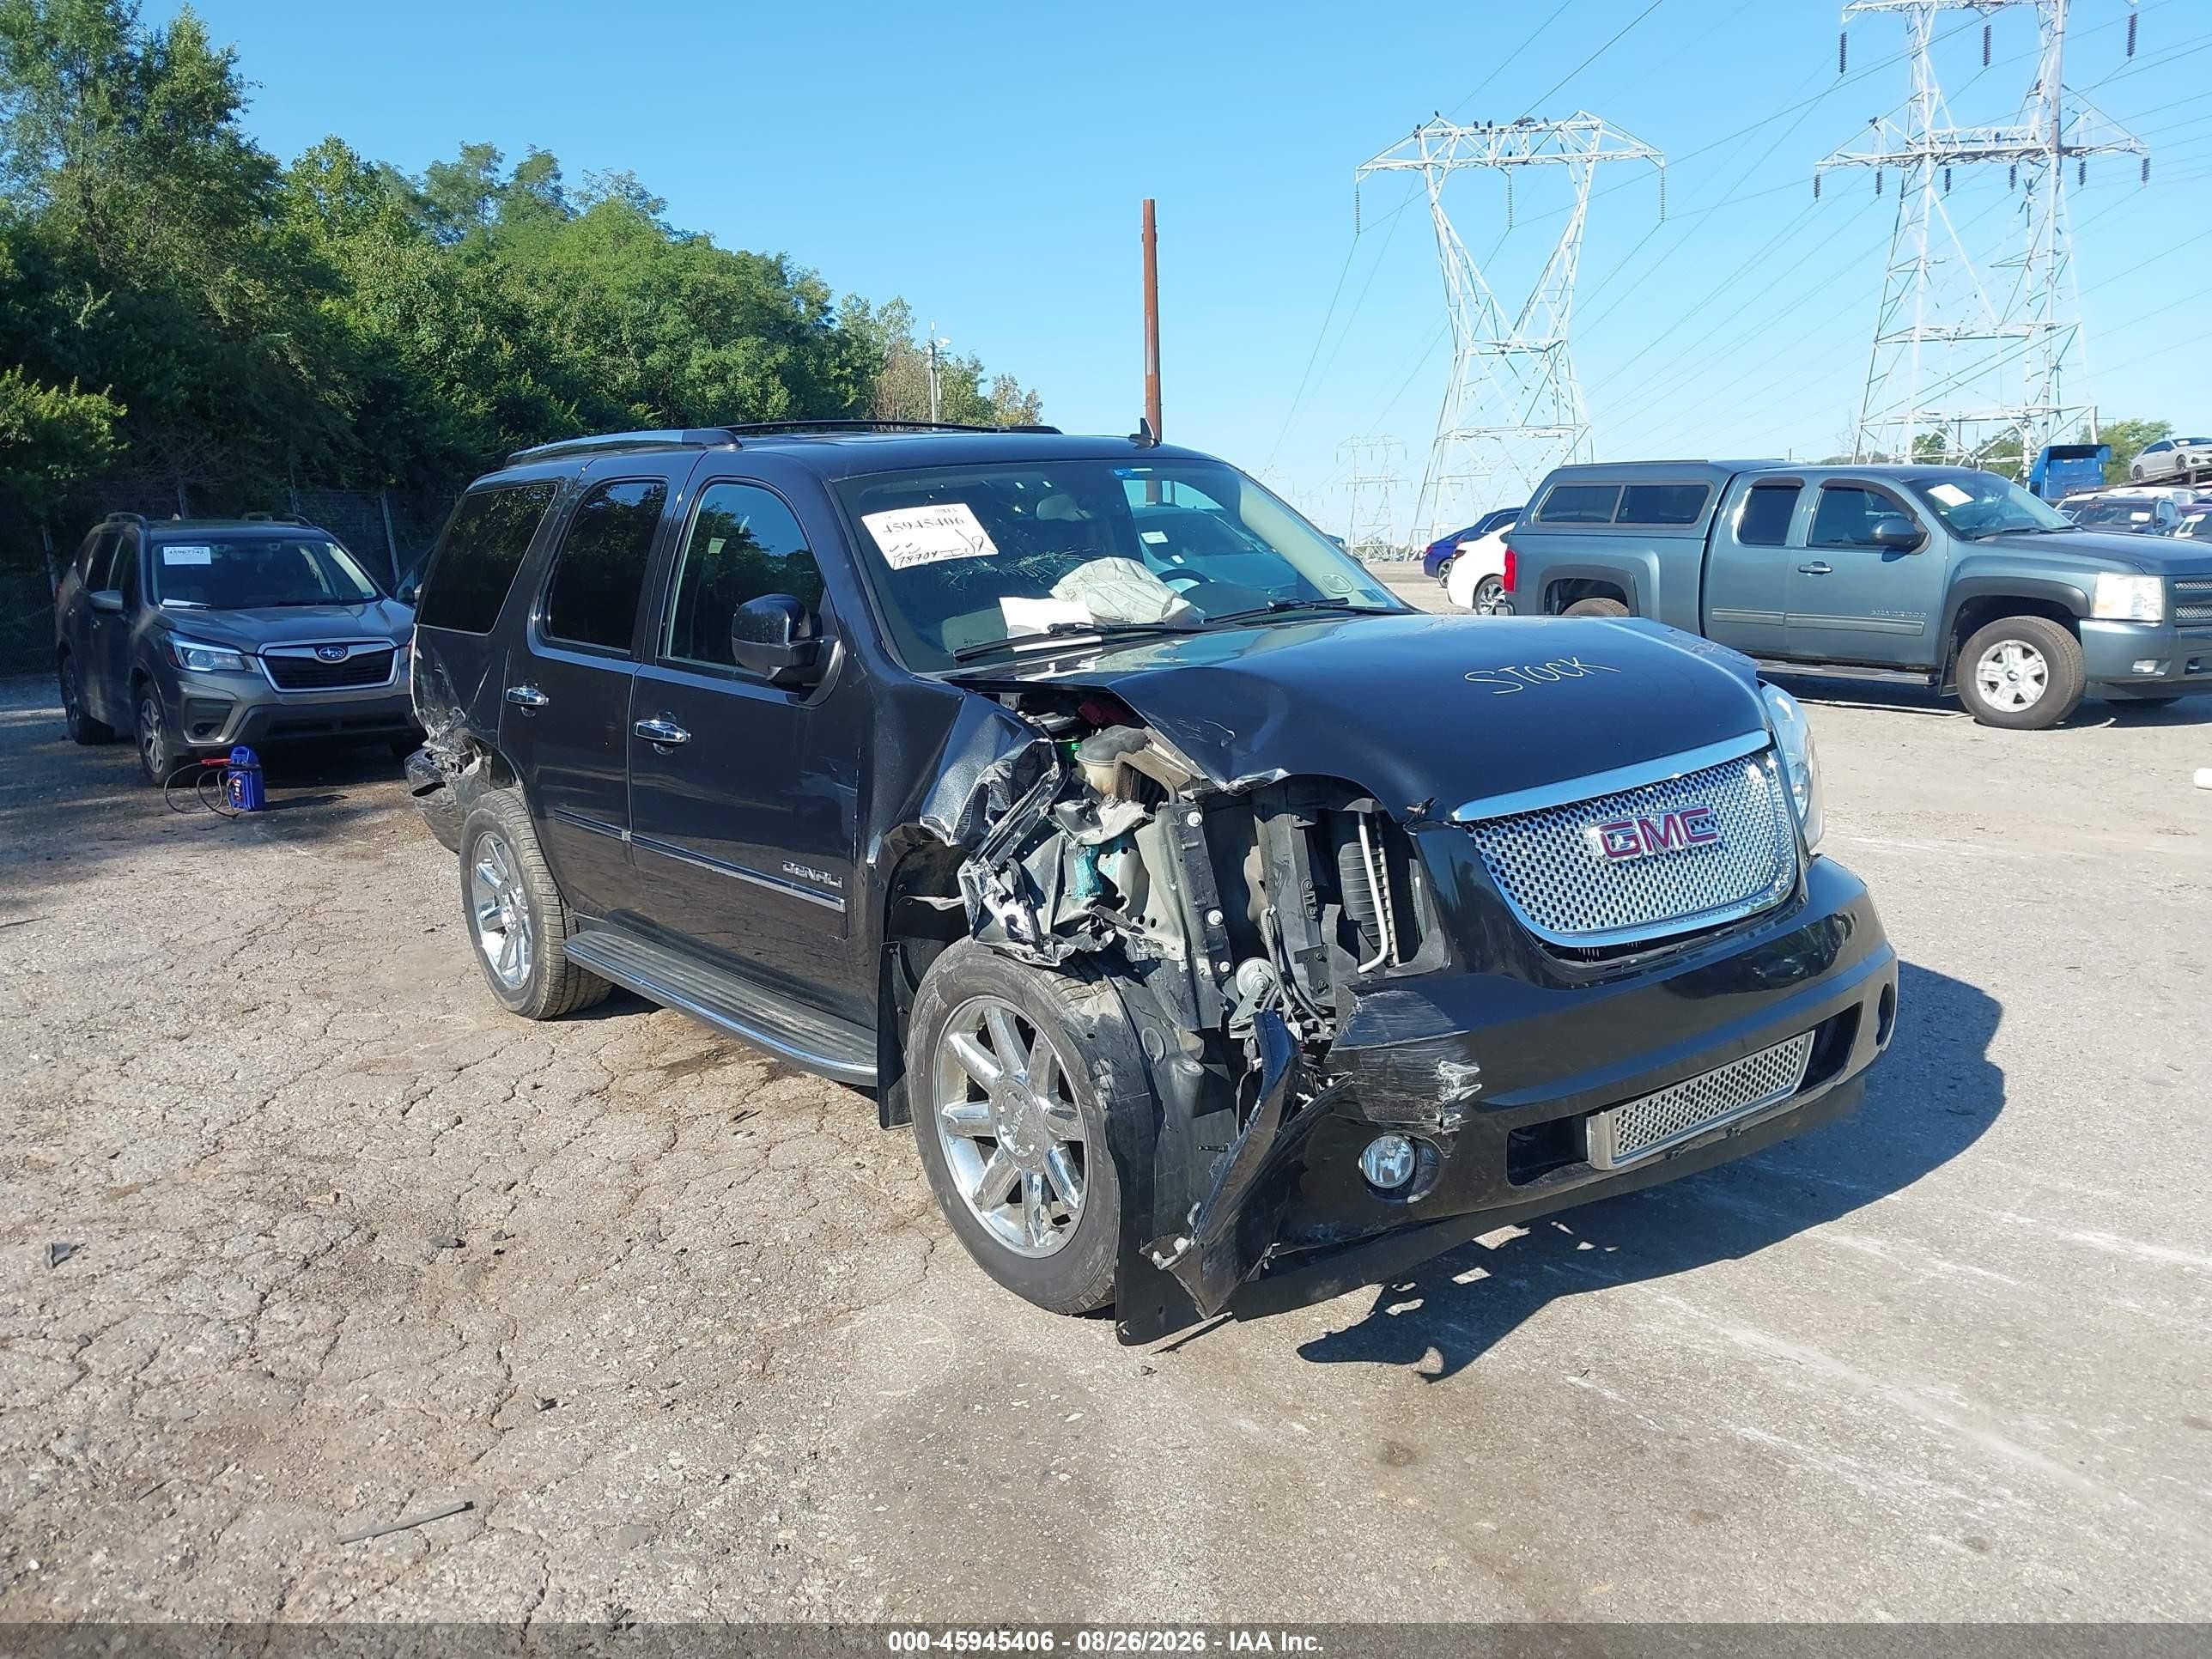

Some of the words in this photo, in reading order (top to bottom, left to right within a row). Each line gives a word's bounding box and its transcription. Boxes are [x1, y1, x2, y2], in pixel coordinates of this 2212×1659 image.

[883, 516, 965, 534] 45945406
[1597, 805, 1719, 860] GMC
[782, 860, 843, 889] DENALI
